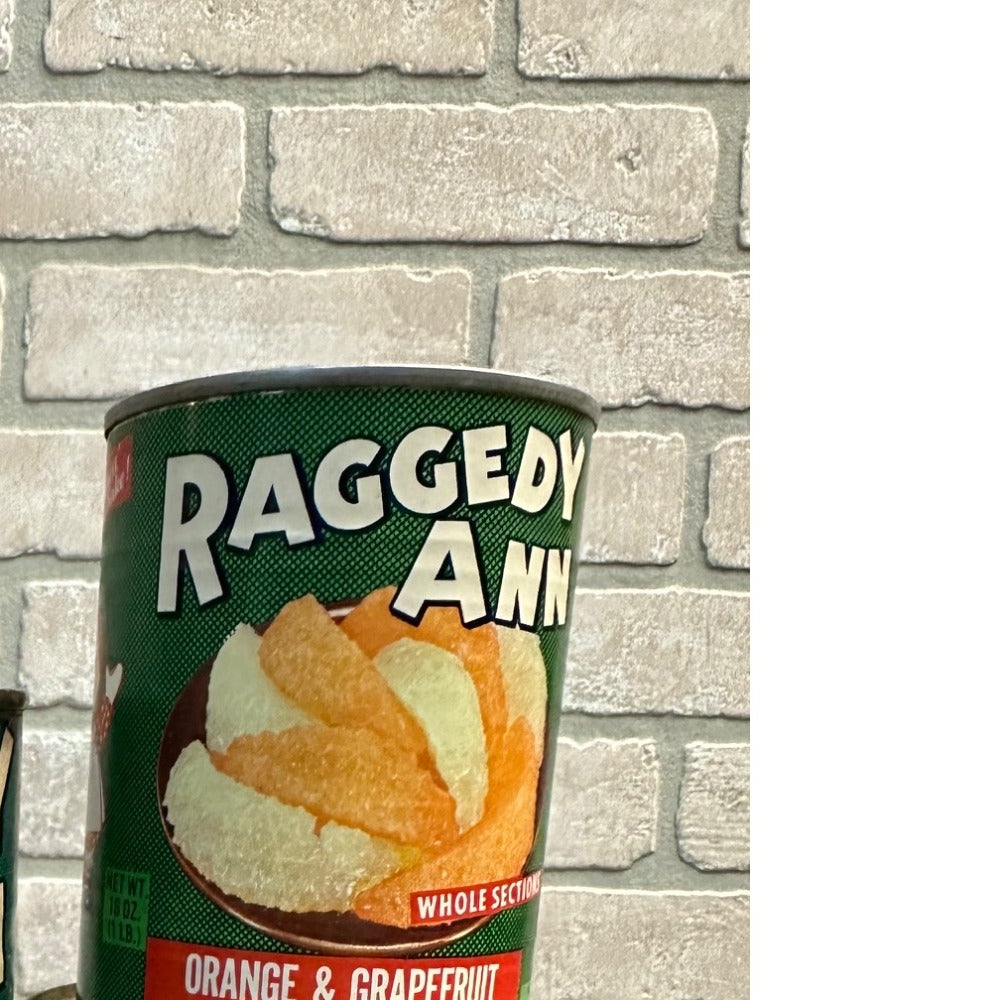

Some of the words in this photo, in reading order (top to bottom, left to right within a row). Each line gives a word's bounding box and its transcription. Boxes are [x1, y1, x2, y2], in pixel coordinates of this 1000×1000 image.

[157, 424, 585, 613] RAGGEDY
[392, 519, 572, 626] ANN
[417, 888, 487, 920] WHOLE
